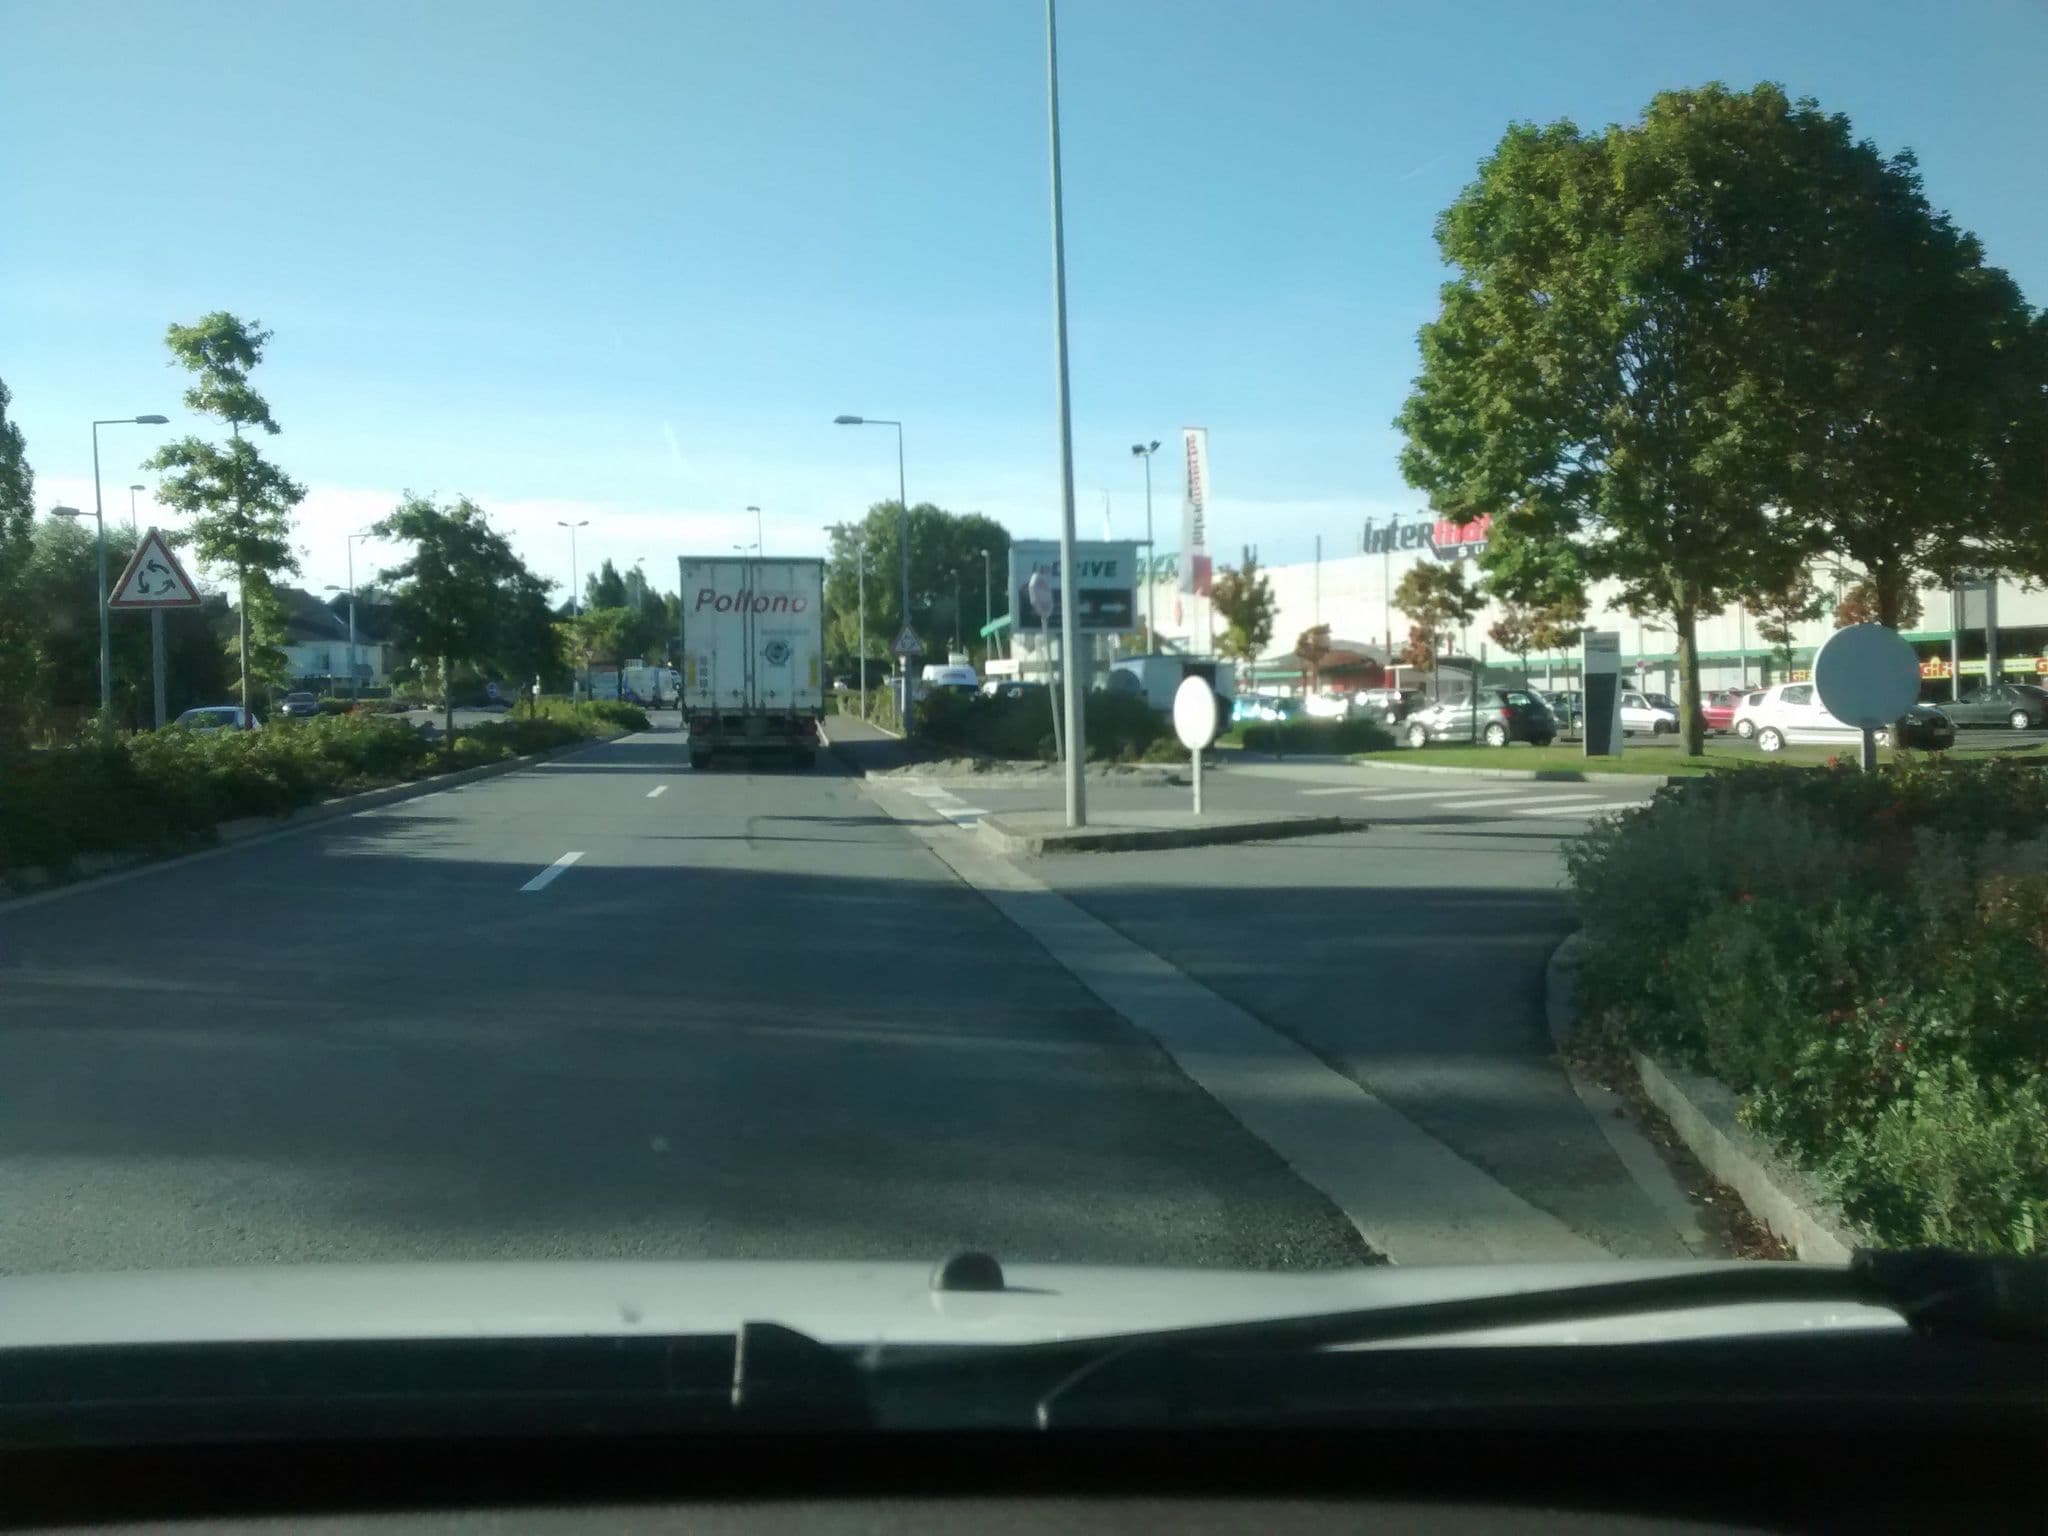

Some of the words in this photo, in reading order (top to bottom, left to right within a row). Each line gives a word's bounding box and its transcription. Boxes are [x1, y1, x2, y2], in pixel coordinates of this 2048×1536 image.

[1363, 512, 1489, 554] Intermar
[1458, 544, 1485, 557] SU
[696, 588, 808, 613] Pollono
